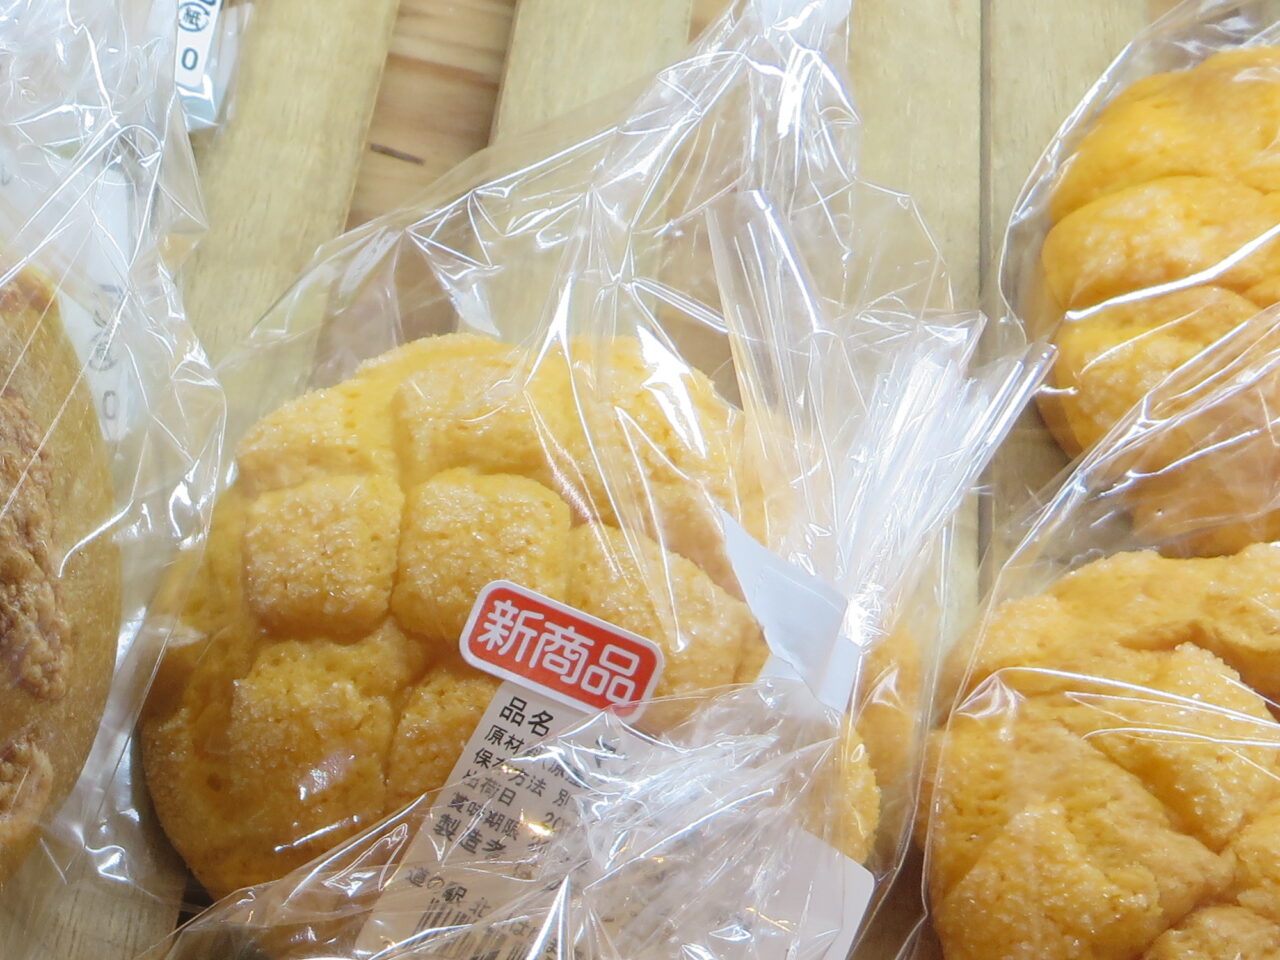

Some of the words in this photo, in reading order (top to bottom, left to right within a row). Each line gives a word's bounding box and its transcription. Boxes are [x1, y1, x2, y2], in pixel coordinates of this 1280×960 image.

[476, 600, 640, 705] 新商品
[499, 696, 554, 737] 品名
